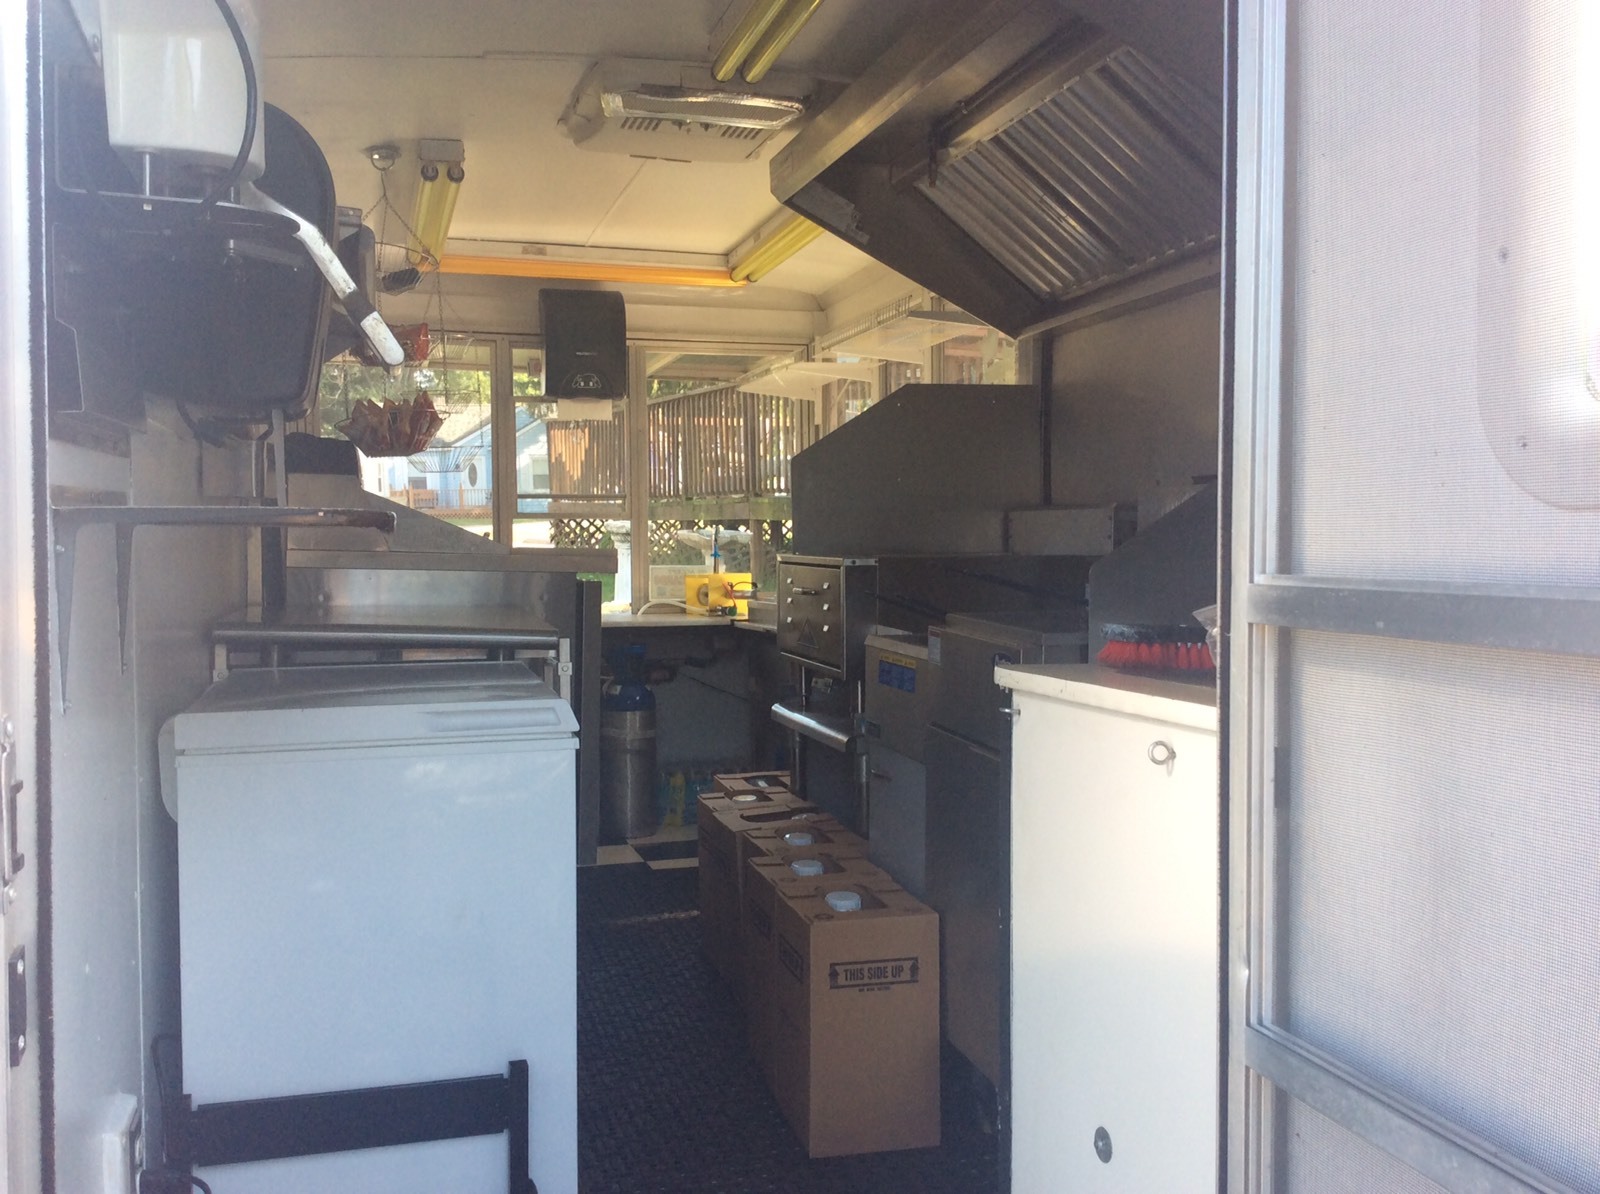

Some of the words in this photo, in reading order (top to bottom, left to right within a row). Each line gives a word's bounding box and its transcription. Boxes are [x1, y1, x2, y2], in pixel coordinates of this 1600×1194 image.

[843, 968, 865, 982] THIS
[867, 966, 889, 980] SIDE
[891, 965, 904, 978] UP
